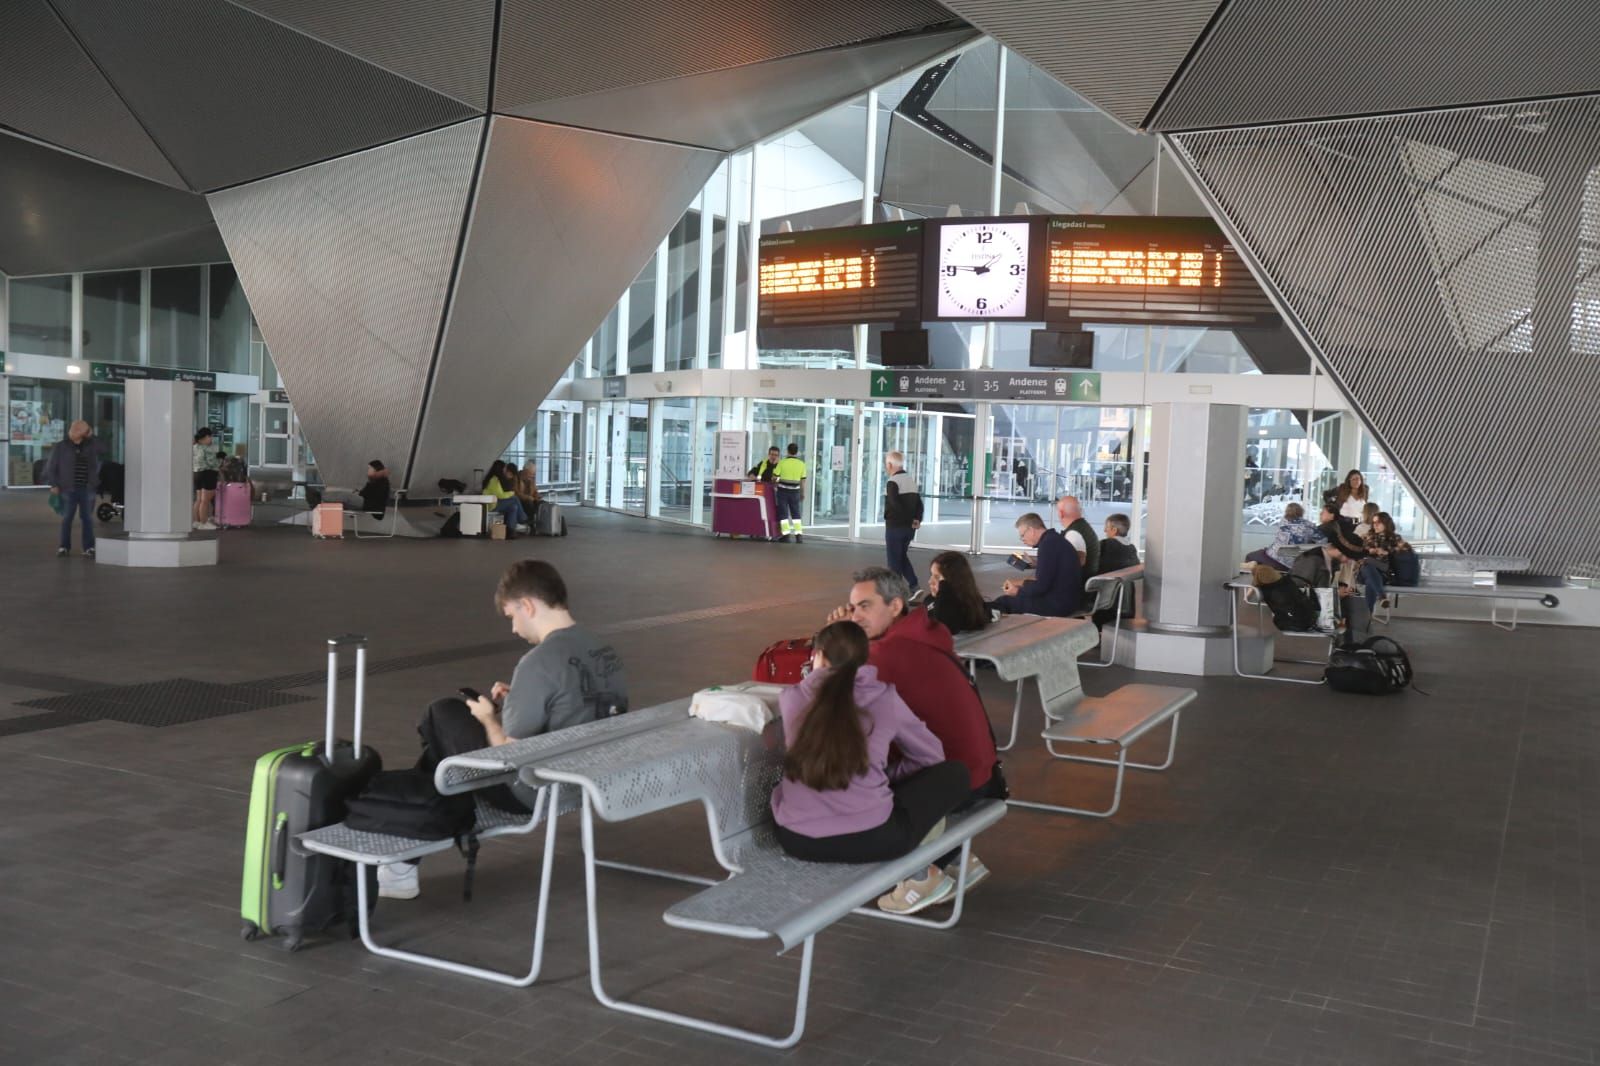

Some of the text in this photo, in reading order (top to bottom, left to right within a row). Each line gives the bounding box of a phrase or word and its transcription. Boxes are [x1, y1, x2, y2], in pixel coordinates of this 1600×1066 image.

[976, 232, 993, 244] 12
[946, 265, 957, 277] 9
[1009, 264, 1020, 276] 3
[976, 298, 987, 310] 6
[915, 376, 947, 385] Andenes
[1009, 378, 1048, 386] Andenes
